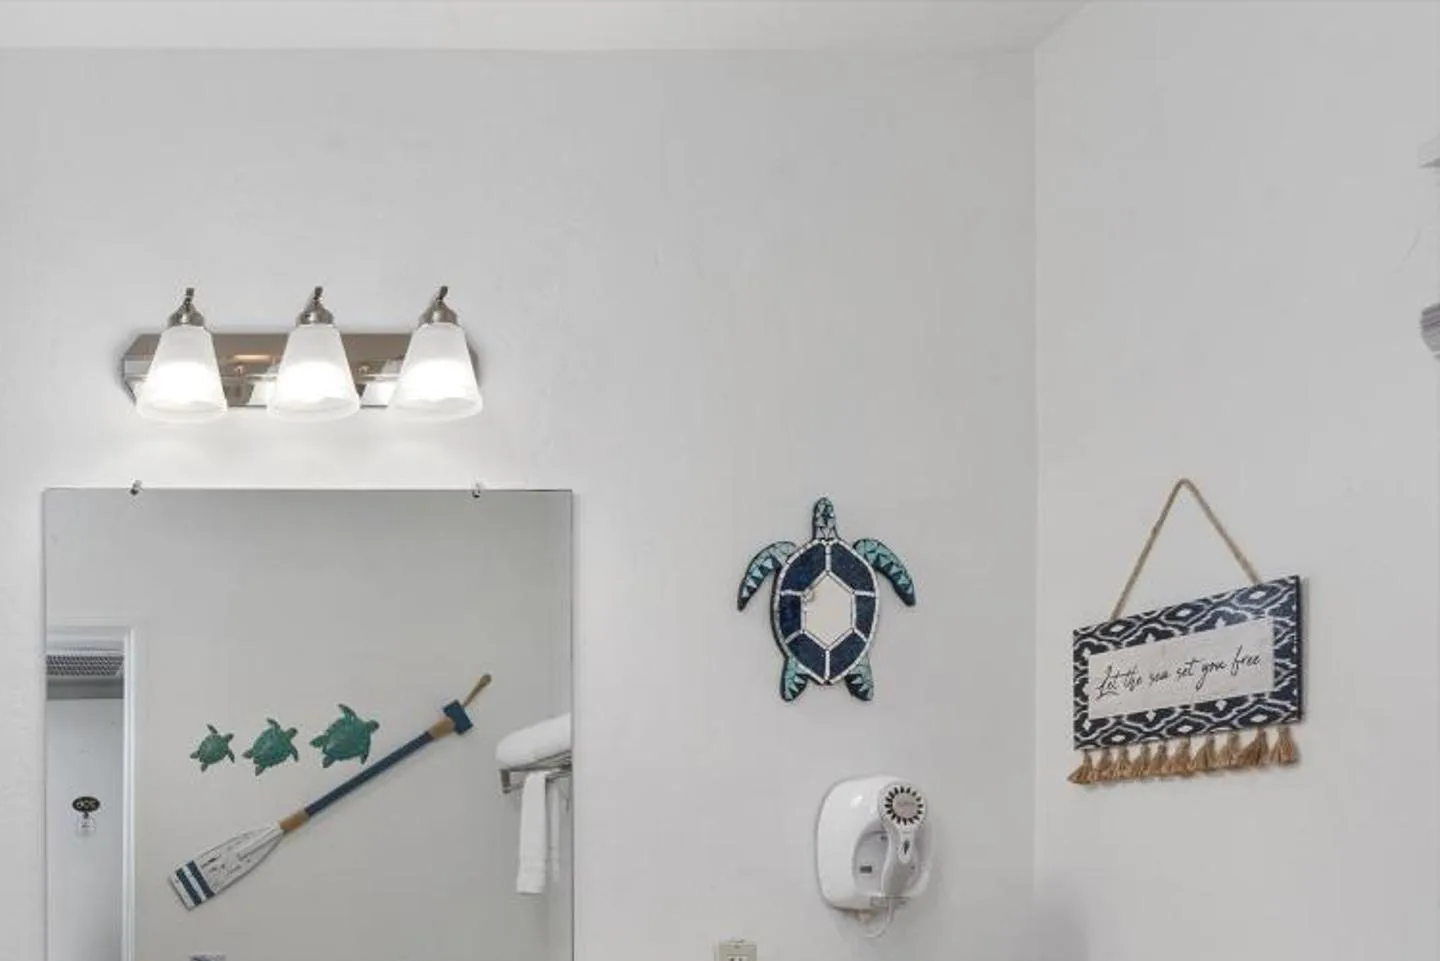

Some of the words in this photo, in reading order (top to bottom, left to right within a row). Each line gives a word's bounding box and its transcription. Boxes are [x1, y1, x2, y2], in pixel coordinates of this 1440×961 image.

[1096, 664, 1122, 700] Let
[1176, 657, 1199, 681] set
[1195, 660, 1226, 691] you
[1230, 645, 1261, 677] free
